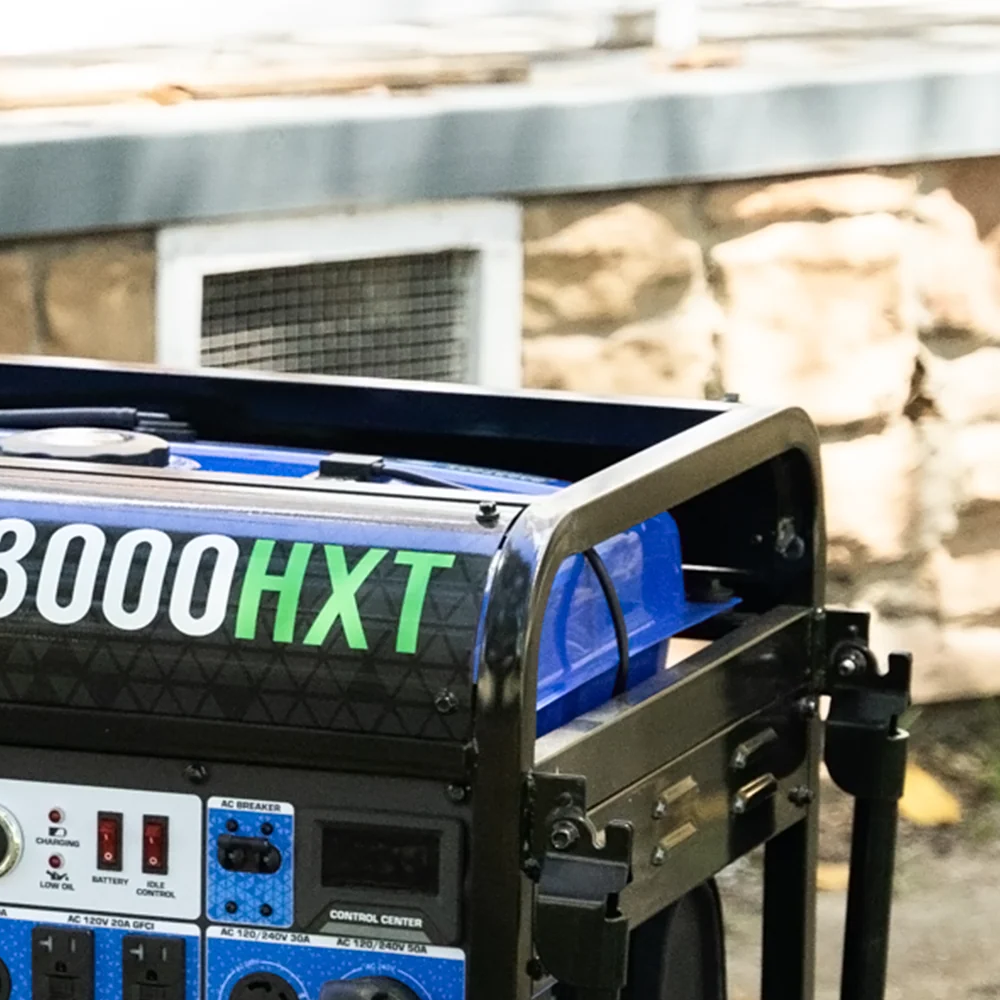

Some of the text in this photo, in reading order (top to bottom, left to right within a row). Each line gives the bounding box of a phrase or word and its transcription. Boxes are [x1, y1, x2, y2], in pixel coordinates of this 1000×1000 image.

[221, 800, 281, 812] AC BREAKER
[36, 837, 80, 848] CHARGING
[40, 881, 75, 891] LOW OIL
[91, 875, 129, 886] BATTERY
[146, 881, 165, 889] IDLE
[135, 888, 176, 899] CONTROL
[67, 915, 155, 930] AC 120V 20A GFCI
[329, 909, 423, 928] CONTROL CENTER
[221, 928, 310, 944] AC 120/240V 30A
[337, 938, 428, 954] AC 120/240V 50A
